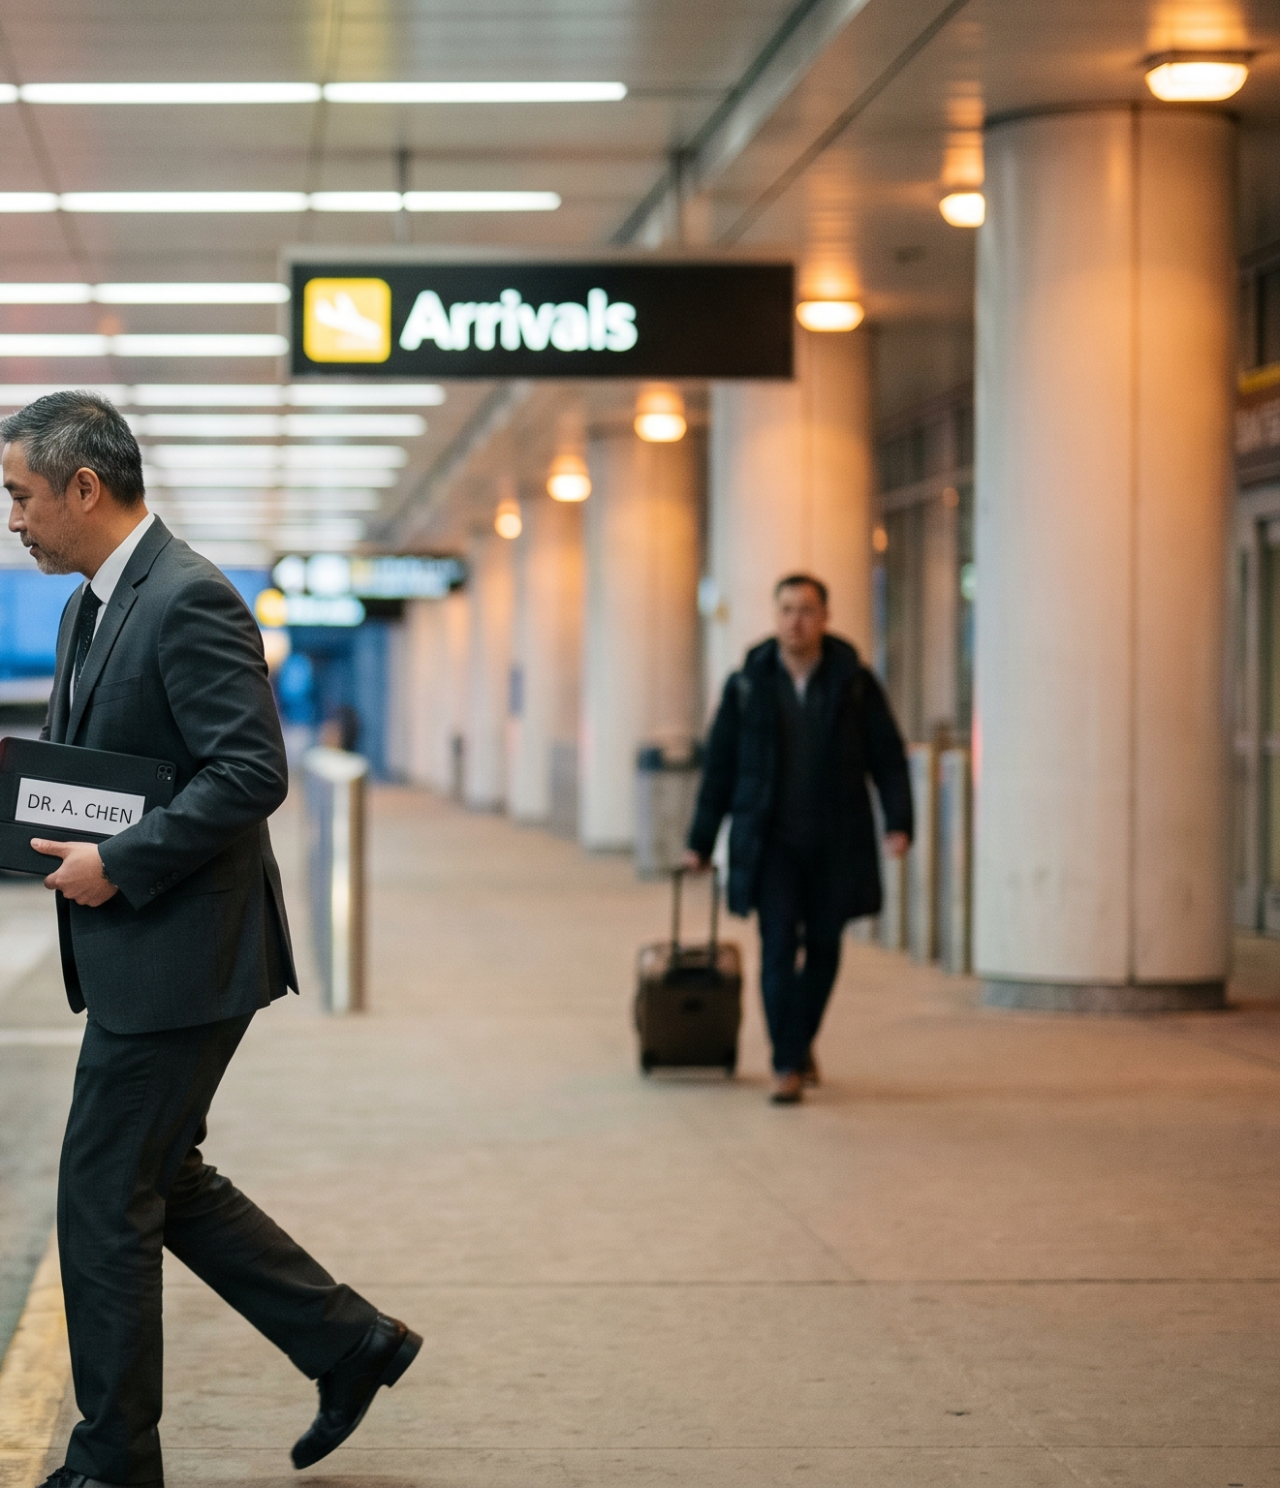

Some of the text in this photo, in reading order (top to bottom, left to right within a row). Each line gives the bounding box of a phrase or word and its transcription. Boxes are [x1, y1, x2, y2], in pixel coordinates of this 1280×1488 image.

[399, 287, 638, 351] Arrivals
[27, 793, 133, 825] DR. A. CHEN
